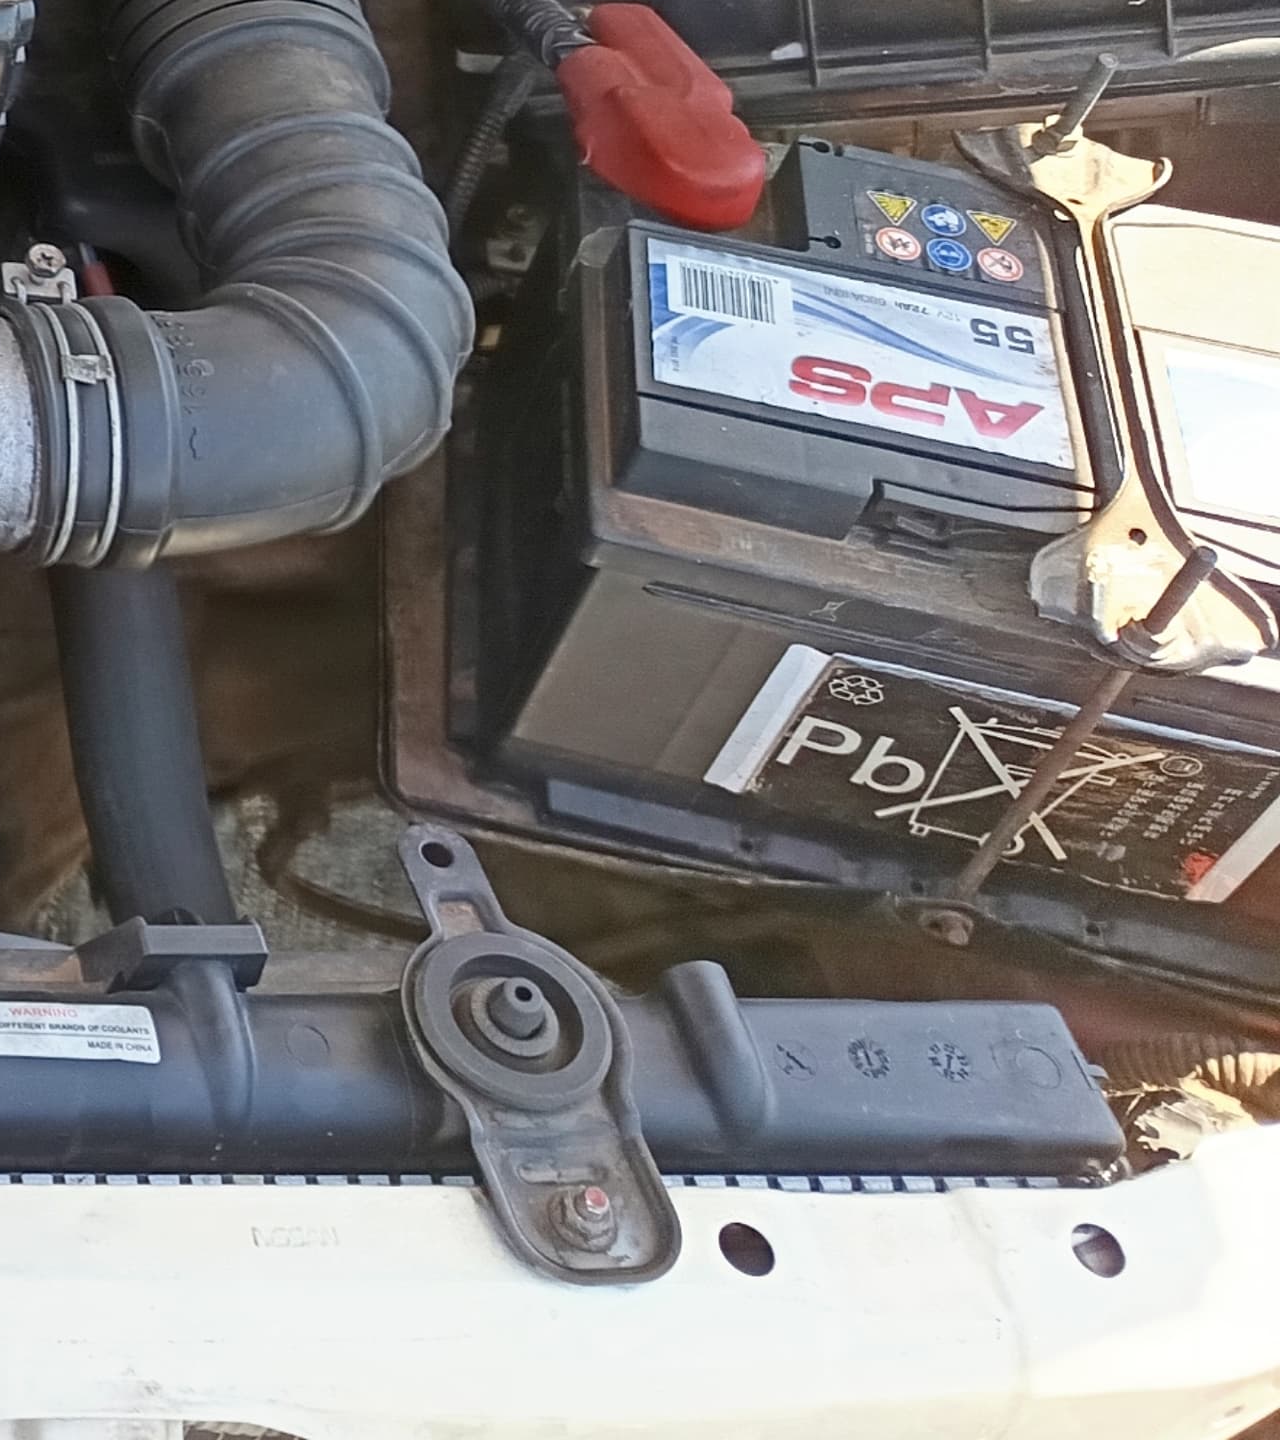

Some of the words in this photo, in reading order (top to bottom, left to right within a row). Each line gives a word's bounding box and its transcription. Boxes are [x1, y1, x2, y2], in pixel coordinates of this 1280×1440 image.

[968, 316, 1036, 356] 55
[788, 354, 1045, 439] APS
[776, 715, 926, 794] Pb
[9, 1007, 78, 1019] WARNING
[48, 1023, 87, 1033] BRANDS
[102, 1025, 150, 1036] COOLANTS
[87, 1040, 114, 1050] MADE
[125, 1042, 153, 1052] CHINA
